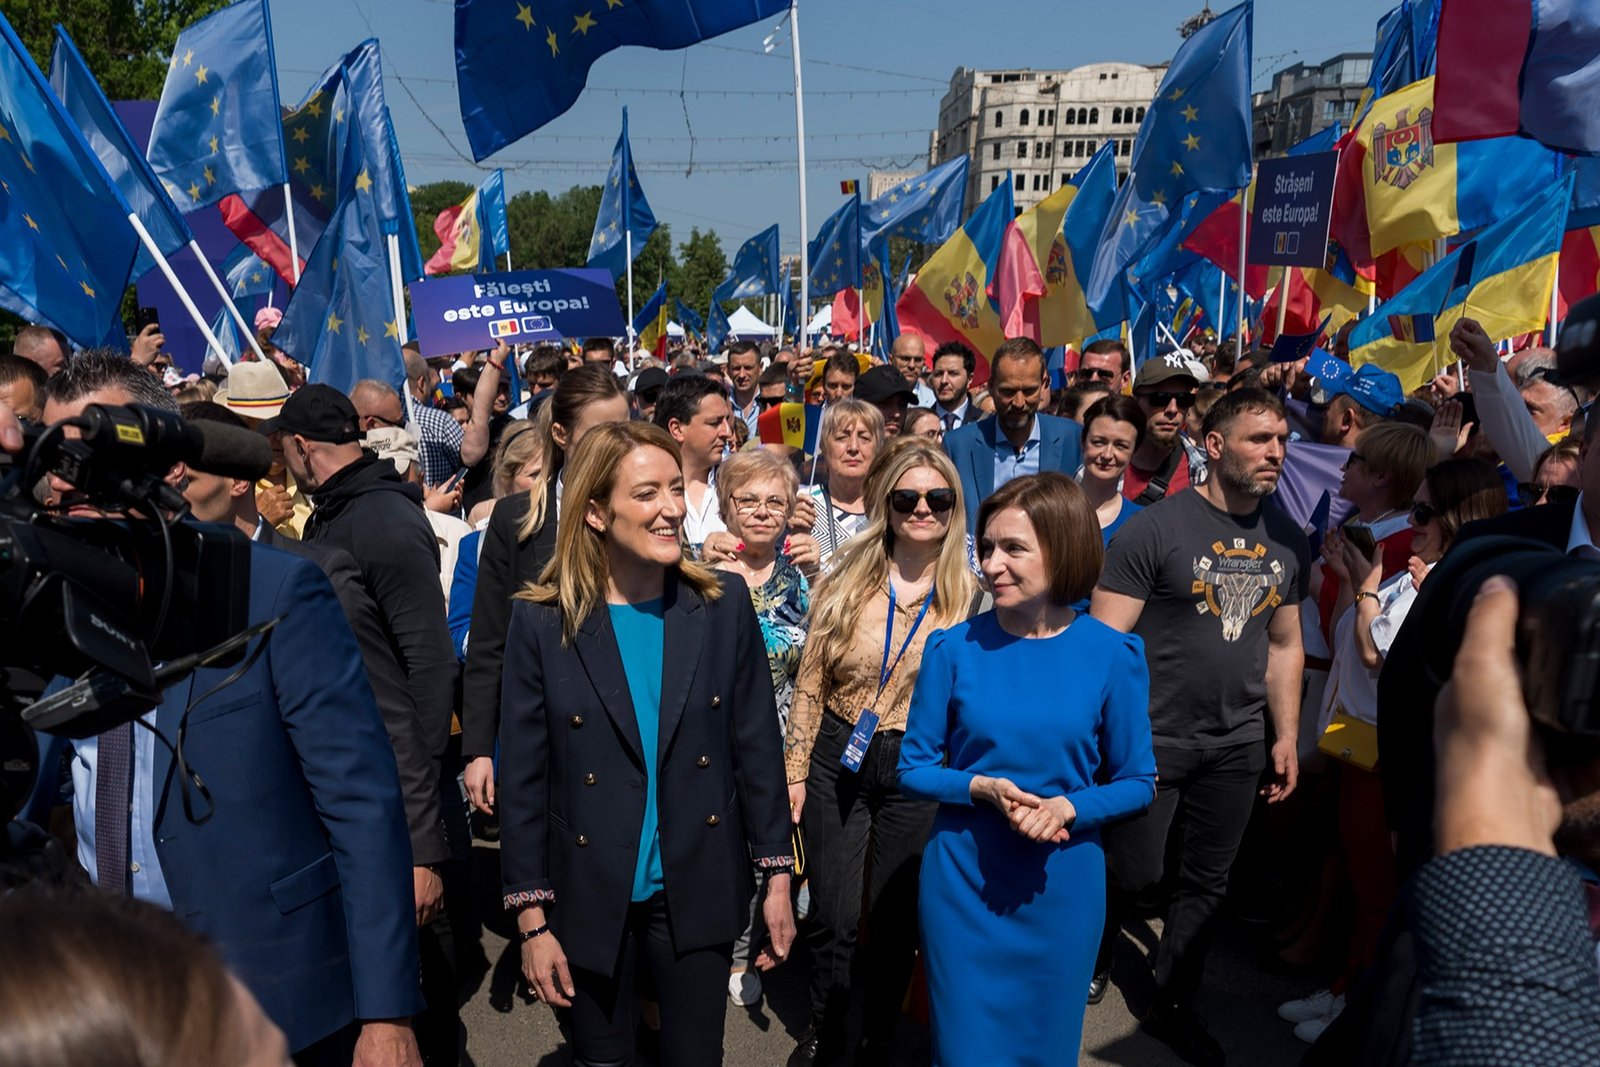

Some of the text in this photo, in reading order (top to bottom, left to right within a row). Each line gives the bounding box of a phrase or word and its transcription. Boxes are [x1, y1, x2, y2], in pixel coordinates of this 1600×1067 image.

[1274, 170, 1315, 200] Strășeni
[1262, 201, 1320, 228] este Europa!
[473, 279, 551, 300] Fălești
[443, 295, 590, 323] este Europa!
[1218, 556, 1264, 572] Wrangler
